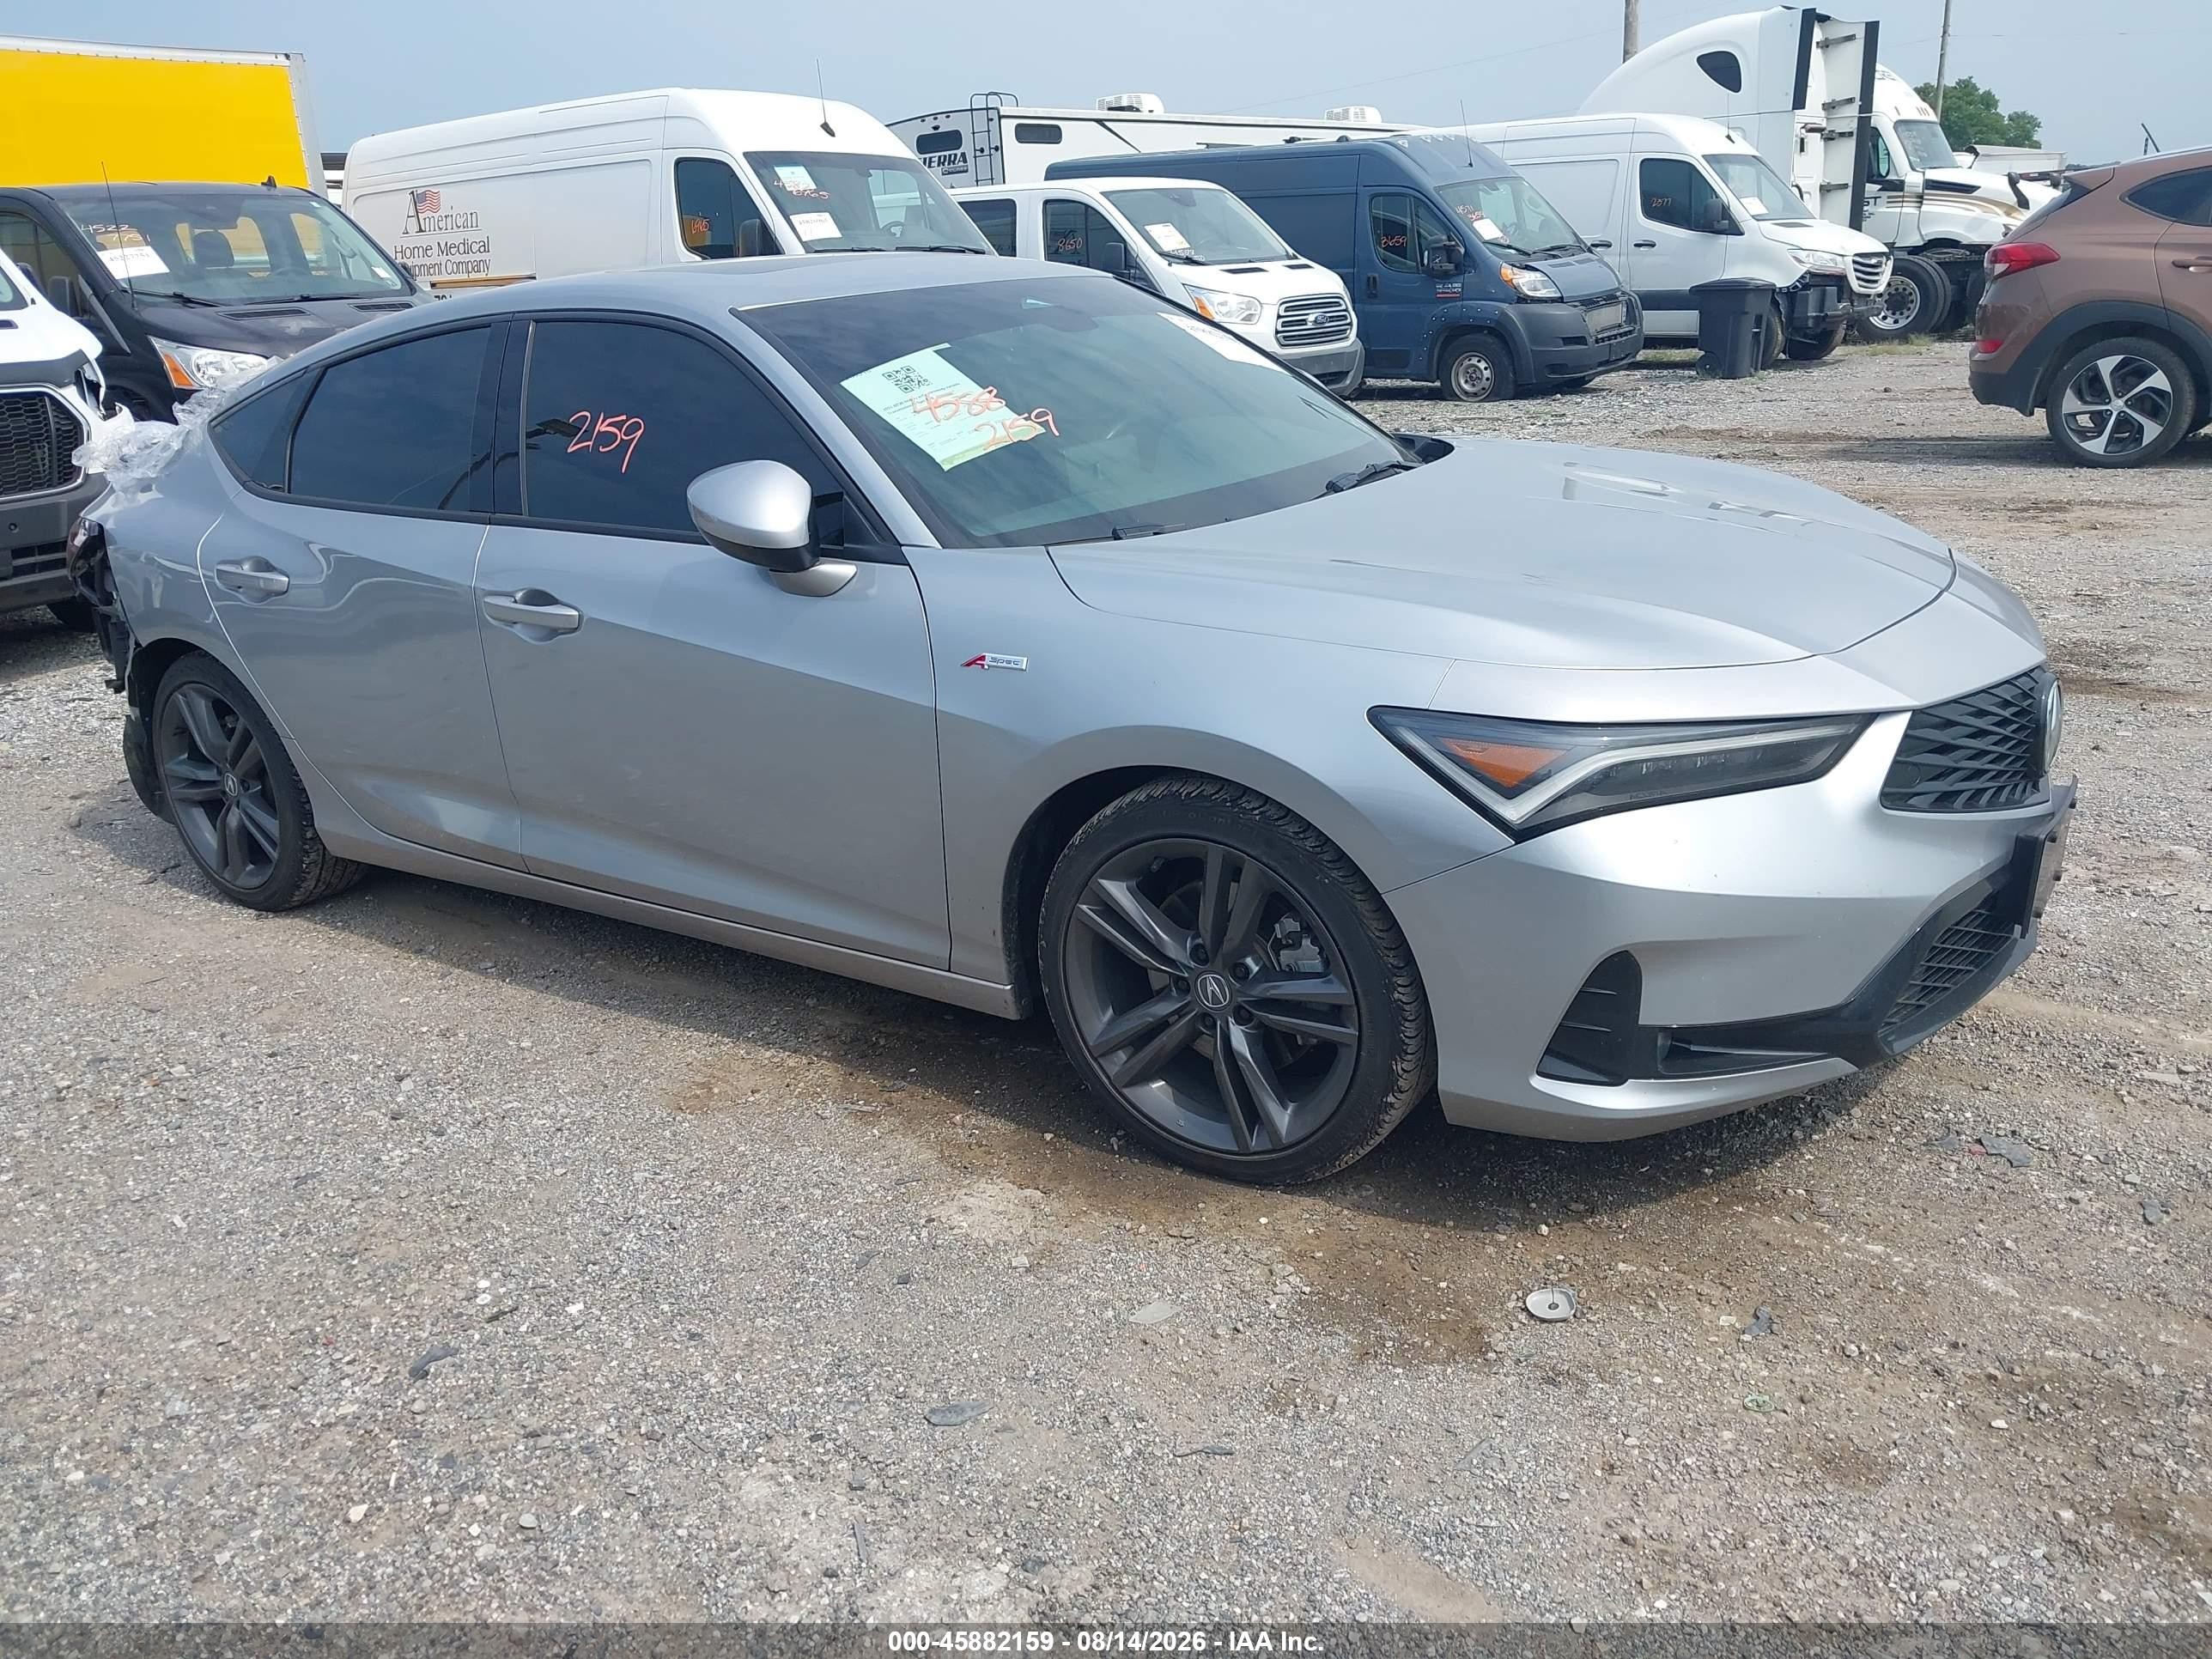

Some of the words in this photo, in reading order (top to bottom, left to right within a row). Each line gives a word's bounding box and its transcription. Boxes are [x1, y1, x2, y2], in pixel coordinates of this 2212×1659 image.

[919, 152, 968, 168] IERRA
[402, 190, 479, 234] American
[81, 224, 133, 234] 4522
[394, 244, 433, 260] Home
[437, 235, 490, 257] Medical
[1057, 237, 1083, 252] 8650
[445, 258, 490, 277] Company
[911, 386, 1006, 422] 4588
[568, 411, 644, 473] 2159
[974, 408, 1060, 451] 2159
